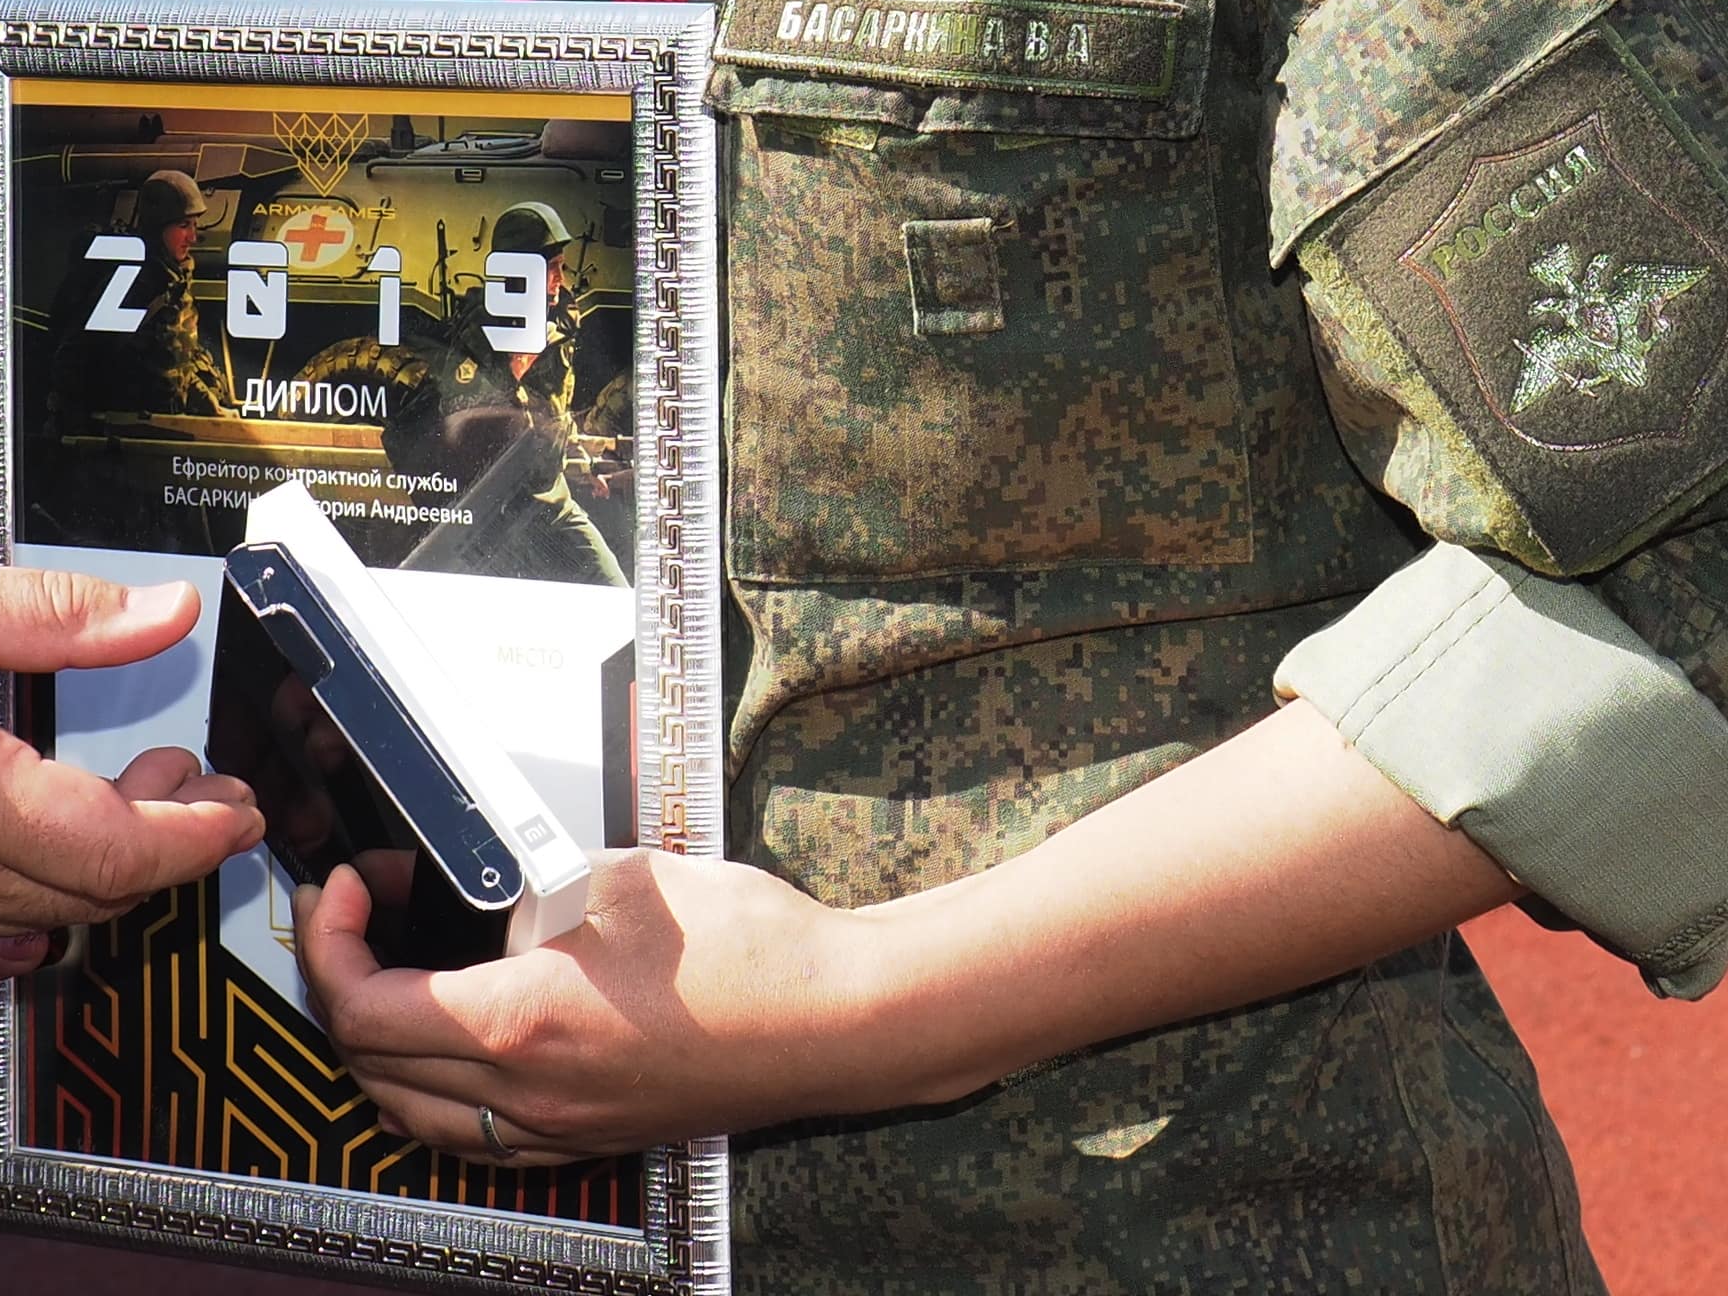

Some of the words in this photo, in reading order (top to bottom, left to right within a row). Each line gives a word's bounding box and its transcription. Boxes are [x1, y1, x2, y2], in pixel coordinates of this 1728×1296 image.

[776, 0, 1005, 62] БАСАРКИНА
[1431, 144, 1600, 279] РОССИЯ
[241, 378, 387, 418] ДИПЛОМ
[172, 456, 260, 484] Ефрейтор
[264, 466, 381, 489] контрактной
[386, 471, 458, 494] службы
[370, 500, 473, 525] Андреевна
[496, 645, 564, 670] МЕСТО
